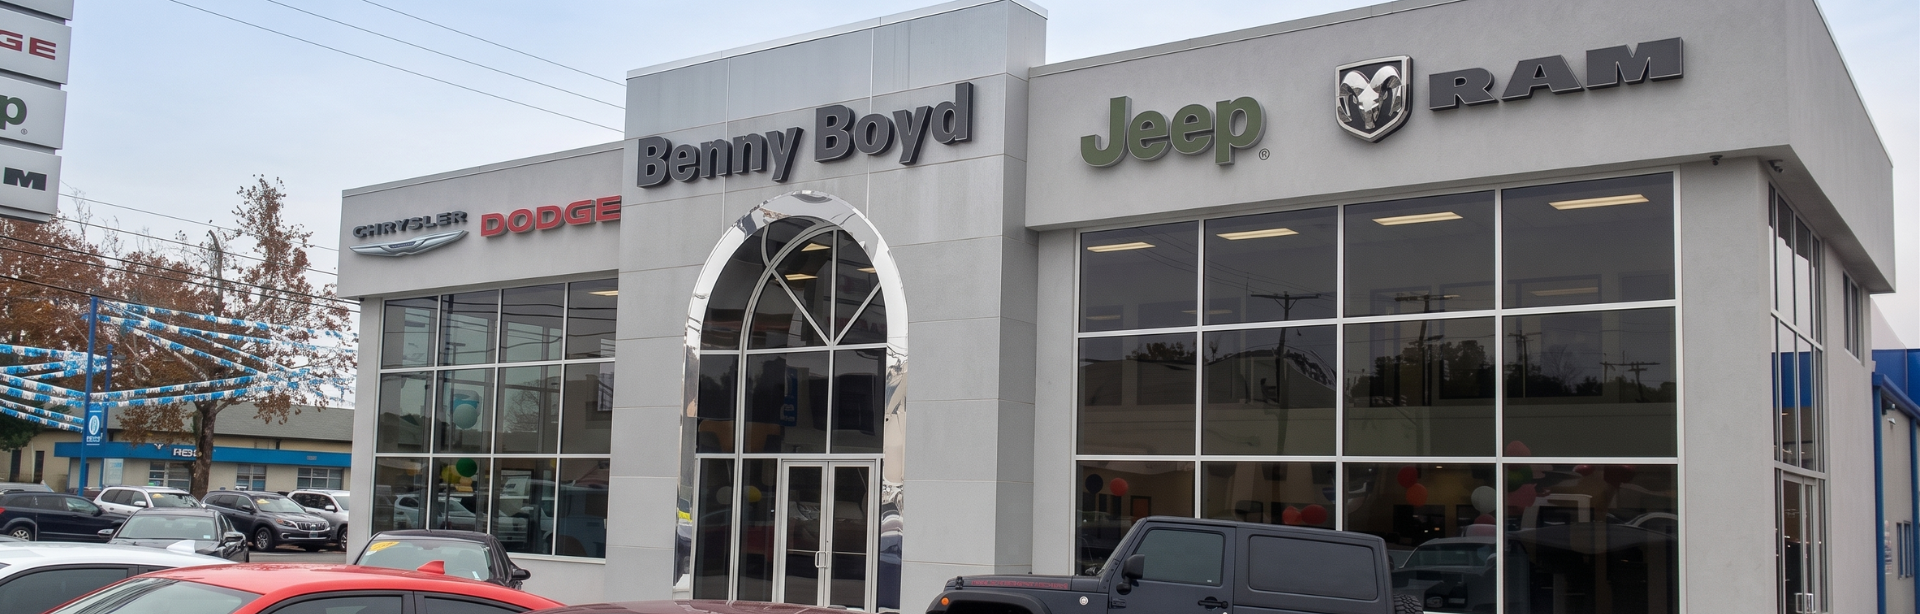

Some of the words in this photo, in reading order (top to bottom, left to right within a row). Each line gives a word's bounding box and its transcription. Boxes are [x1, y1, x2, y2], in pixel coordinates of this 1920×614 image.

[1429, 37, 1683, 111] RAM
[637, 126, 804, 188] Benny
[814, 82, 974, 165] Boyd
[1081, 96, 1267, 167] Jeep
[353, 210, 468, 239] CHRYSLER
[480, 195, 621, 238] DODGE
